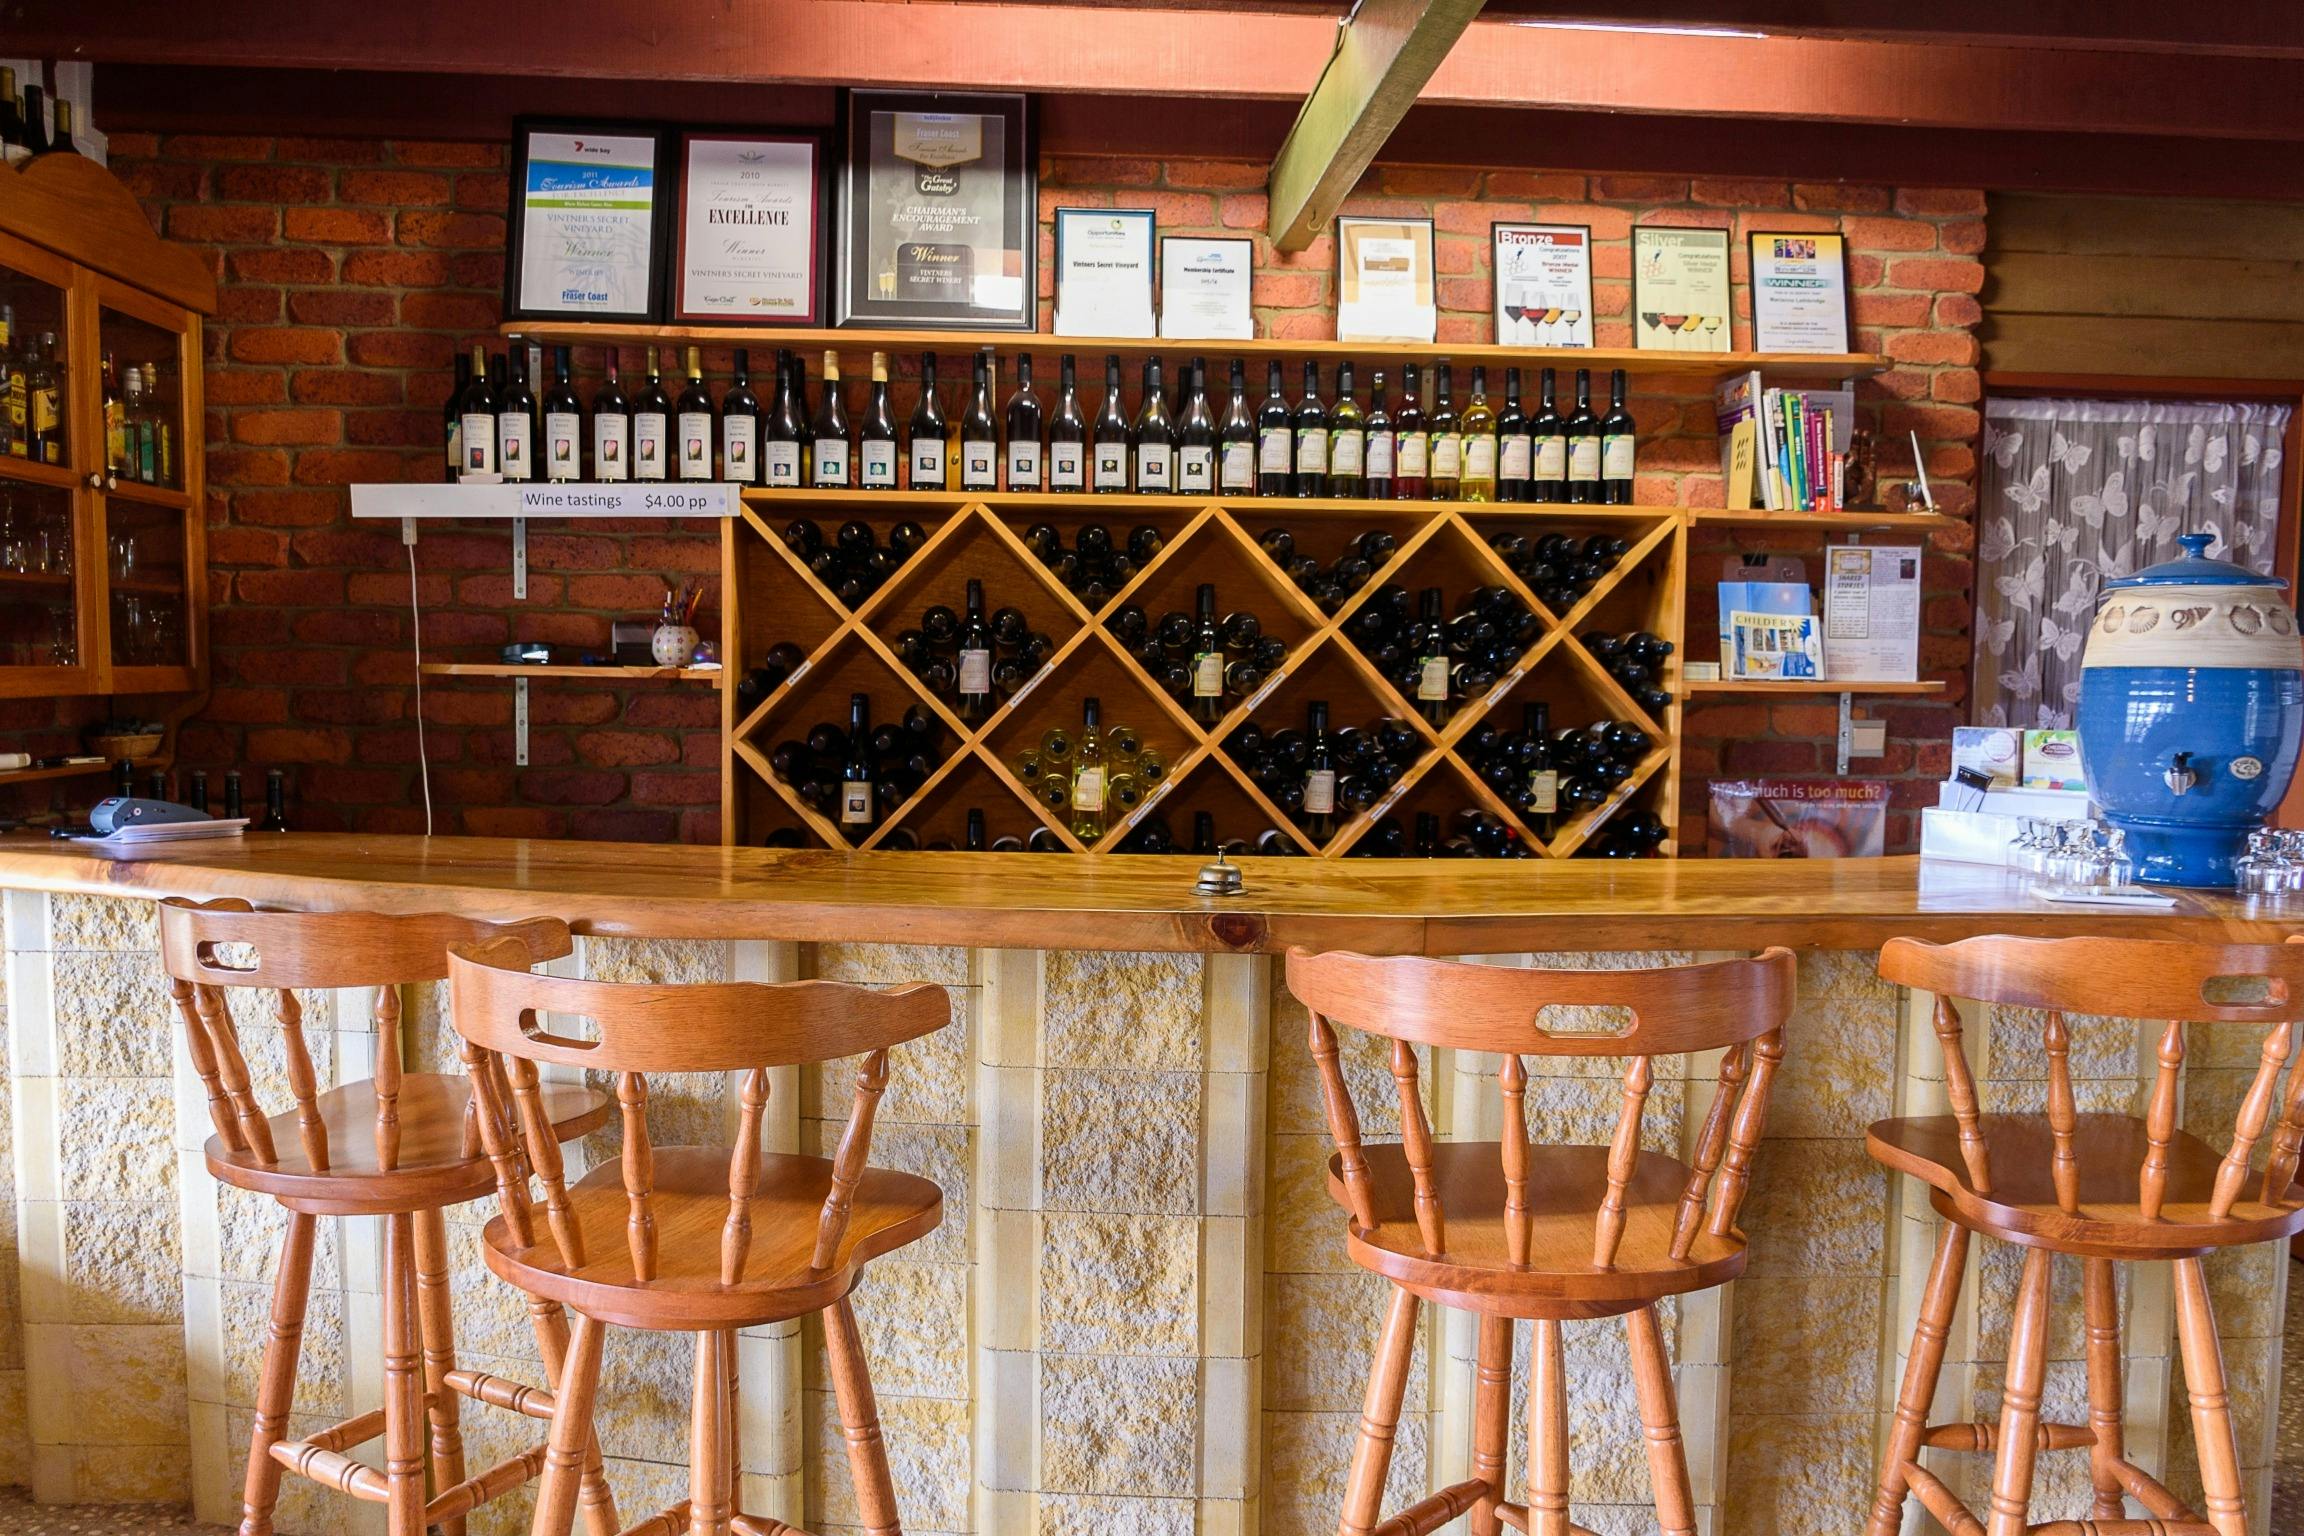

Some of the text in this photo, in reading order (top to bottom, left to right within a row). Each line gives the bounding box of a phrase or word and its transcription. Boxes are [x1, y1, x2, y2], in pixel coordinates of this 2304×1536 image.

[582, 171, 598, 179] 2011
[740, 171, 760, 179] 2010
[933, 174, 953, 184] Great
[540, 175, 639, 191] Tourism Awards
[906, 206, 967, 216] CHAIRMAN'S
[597, 214, 629, 224] SECRET
[709, 208, 789, 226] EXCELLENCE
[892, 214, 981, 225] ENCOURAGEMENT
[564, 223, 613, 234] VINEYARD
[918, 223, 954, 232] AWARD
[1501, 231, 1554, 245] Bronze
[1639, 232, 1684, 247] Silver
[564, 240, 614, 257] Winner
[722, 238, 766, 255] Winner
[910, 246, 961, 263] Winner
[1097, 261, 1113, 269] Secret
[1115, 262, 1139, 270] Vineyard
[734, 270, 761, 279] SECRET
[763, 271, 804, 280] VINEYARD
[909, 276, 935, 284] SECRET
[1767, 279, 1826, 288] WINNER
[562, 290, 608, 302] Fraser Coast
[525, 493, 707, 511] Wine tastings $4.00 pp
[1837, 574, 1863, 582] SHARED
[1836, 581, 1866, 589] STORIES
[1735, 615, 1795, 627] CHILDERS
[1753, 784, 1788, 798] much
[1792, 784, 1805, 798] is
[1807, 785, 1832, 799] too
[1834, 784, 1882, 800] much?
